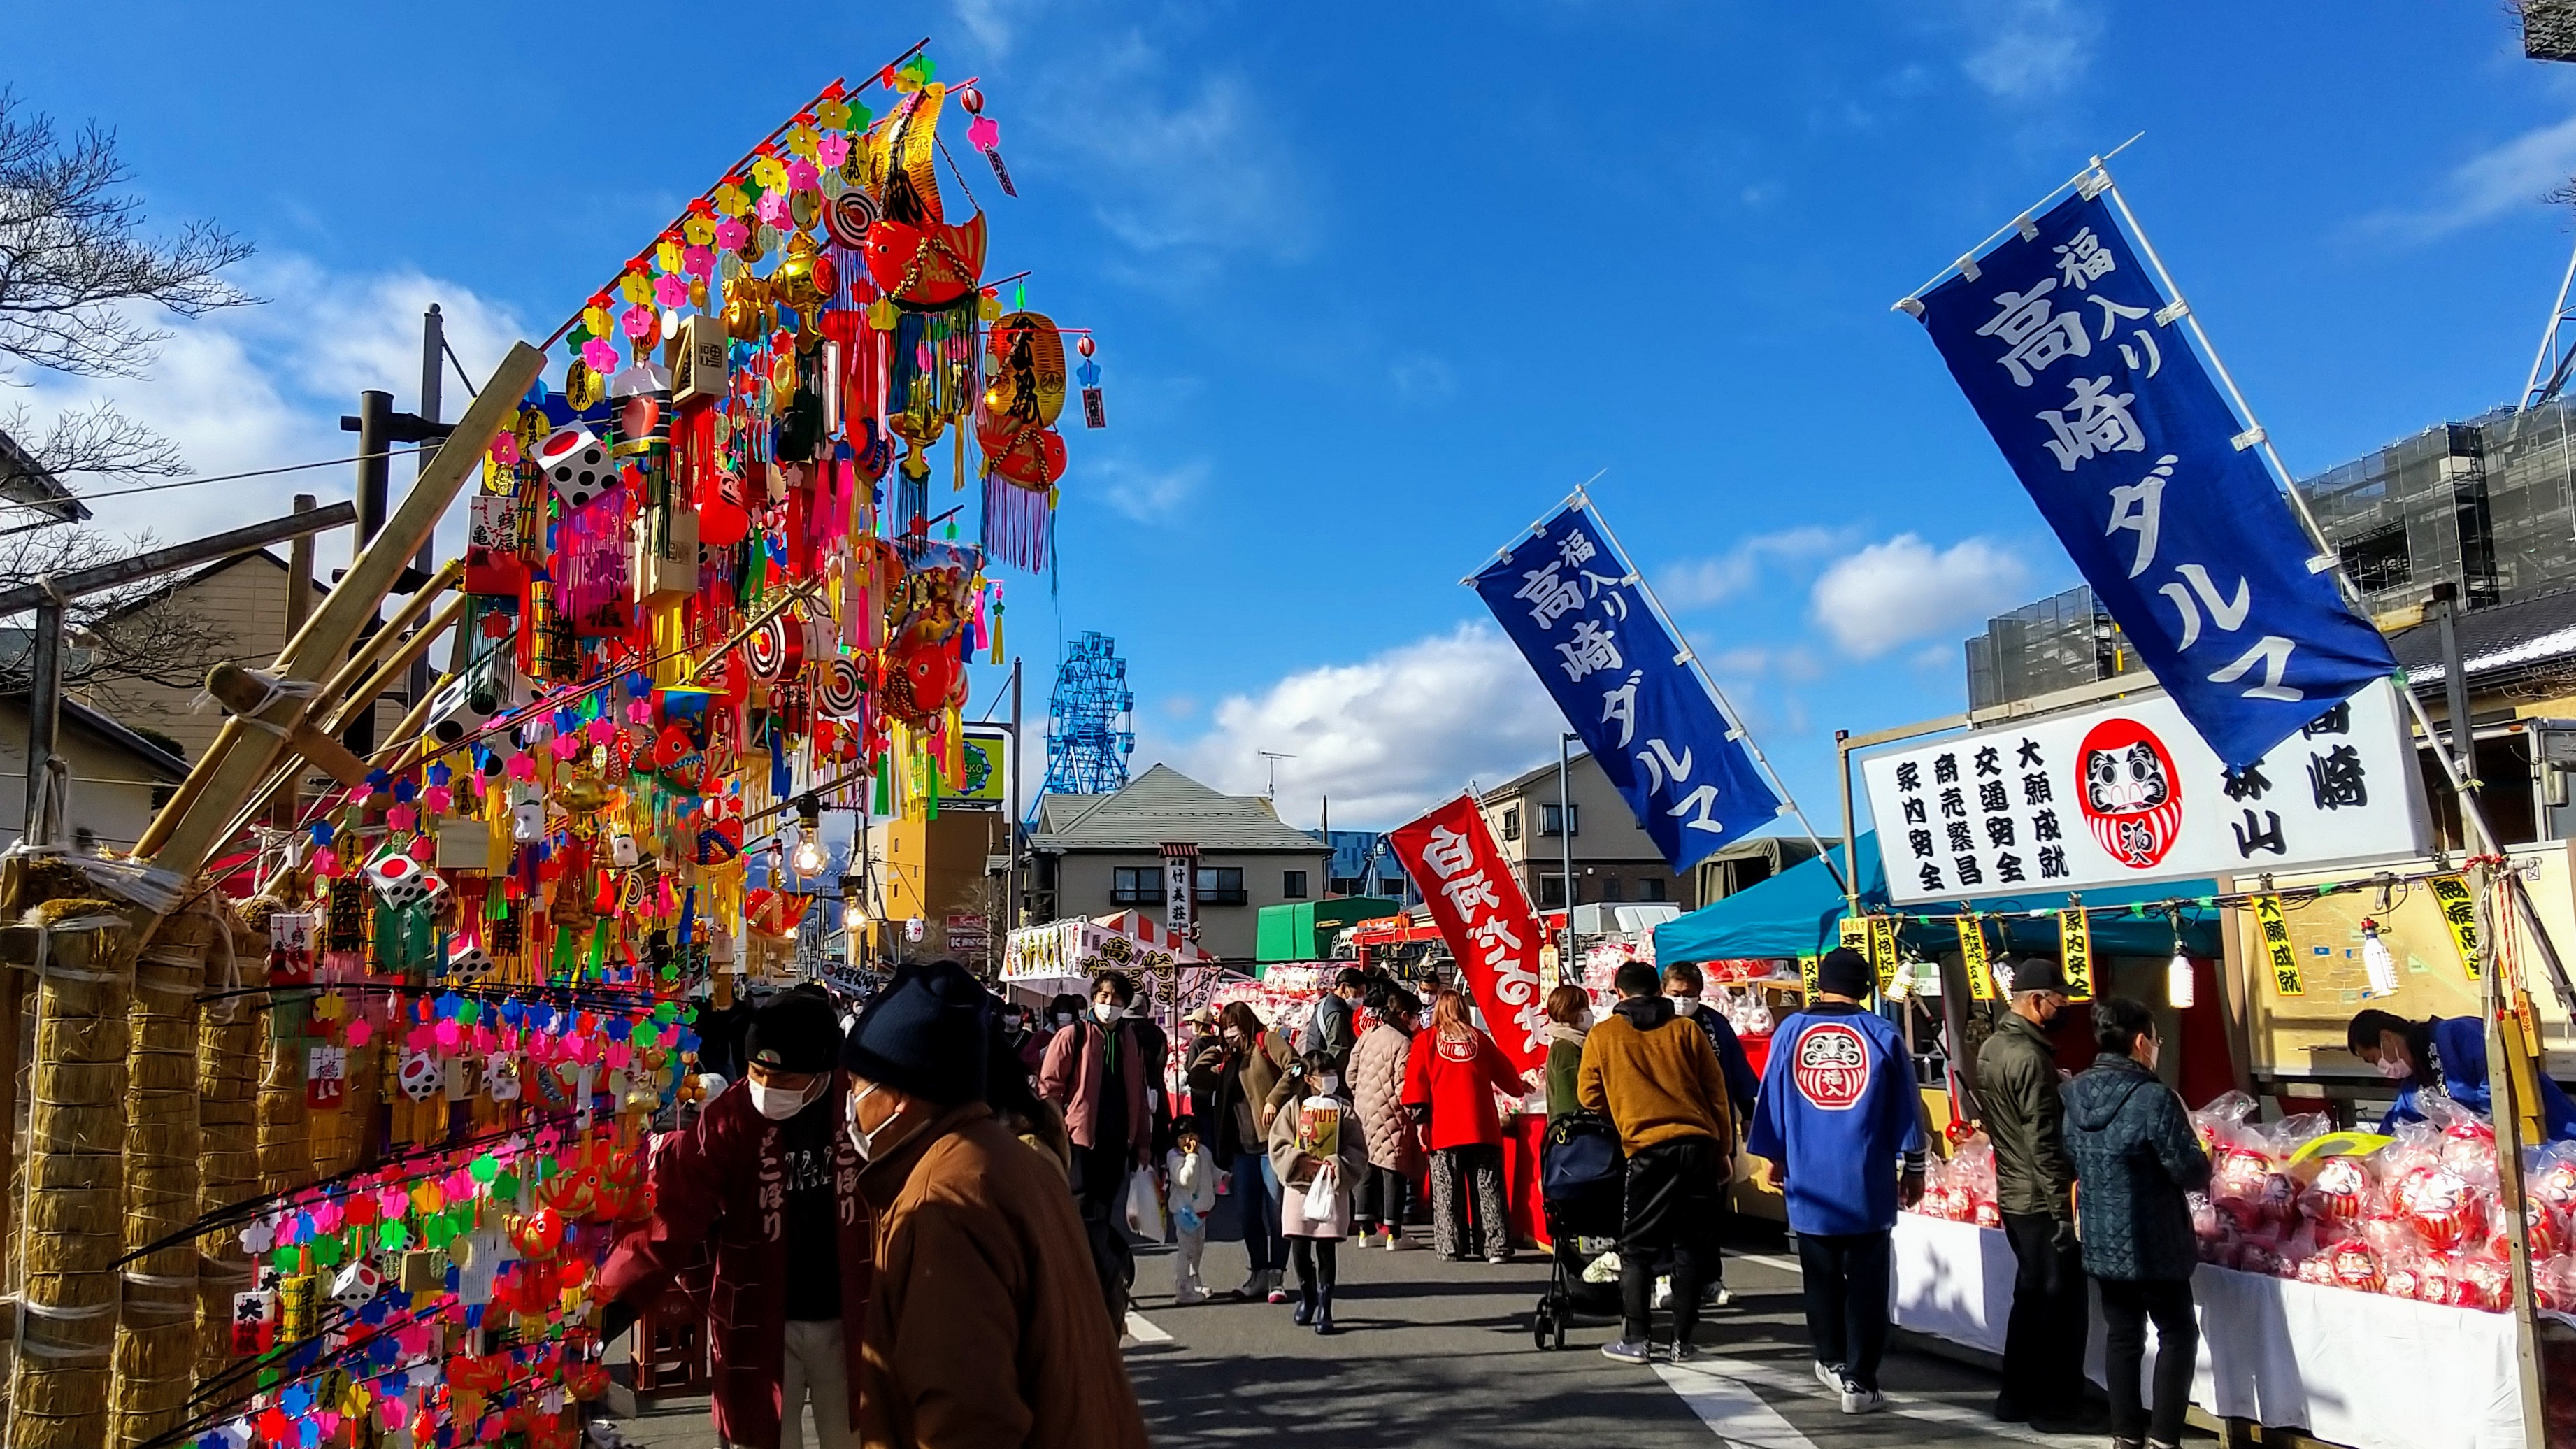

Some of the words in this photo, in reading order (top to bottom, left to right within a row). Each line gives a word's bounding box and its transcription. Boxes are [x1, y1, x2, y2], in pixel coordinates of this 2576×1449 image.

[2055, 227, 2161, 380] 福入り
[1975, 277, 2304, 703] 高崎ダルマ
[1557, 528, 1628, 622] 福入り
[1513, 560, 1724, 834] 高崎ダルマ
[1896, 761, 1945, 892] 家内安全
[1933, 752, 1983, 887] 商売繁昌
[1973, 745, 2026, 883] 交通安全
[2016, 736, 2070, 879] 大願成就
[1172, 869, 1187, 921] 竹美荘
[2256, 896, 2303, 994] 大願成就
[1821, 1069, 1846, 1097] 福入
